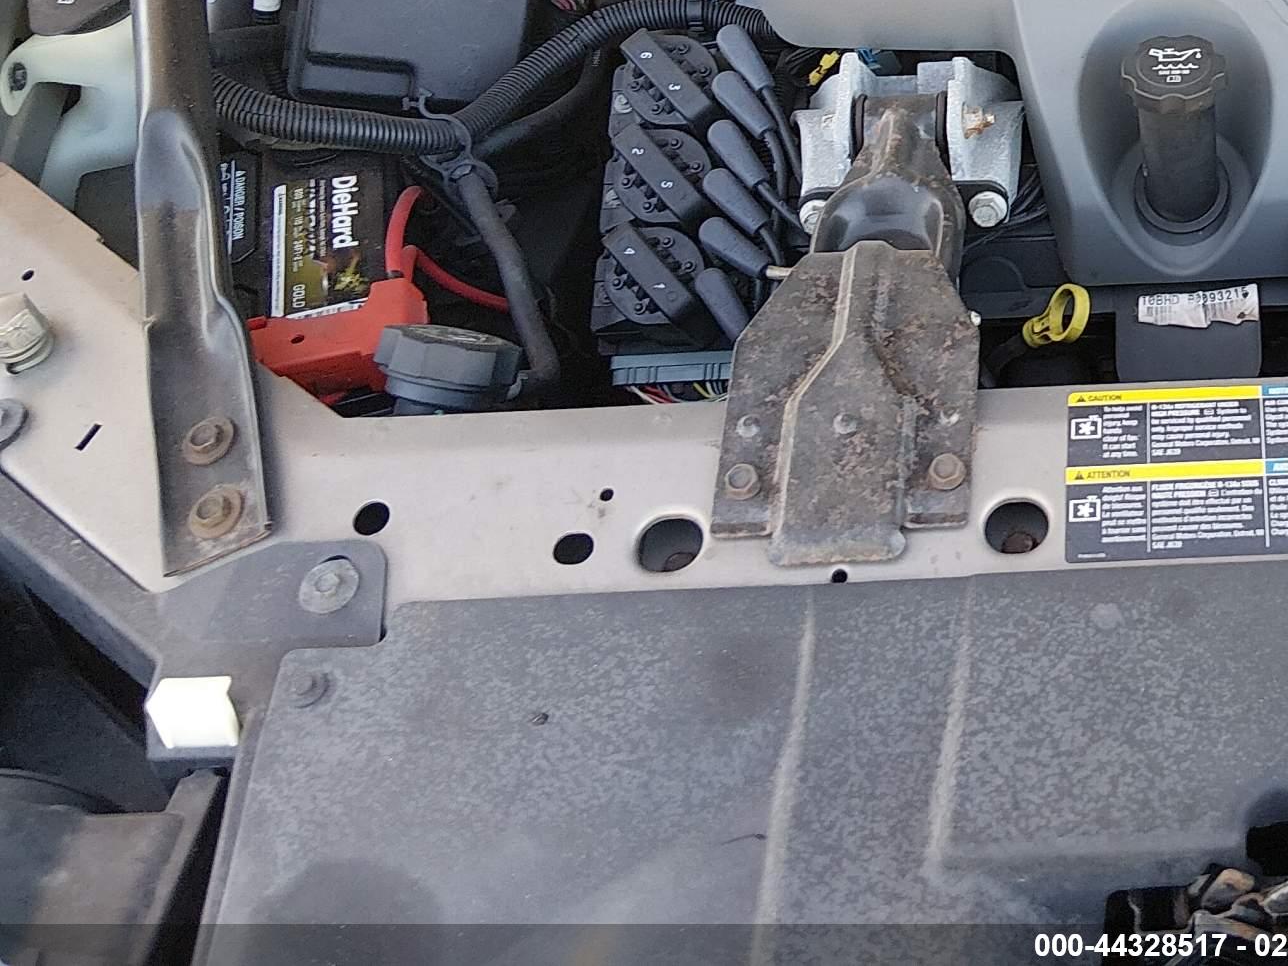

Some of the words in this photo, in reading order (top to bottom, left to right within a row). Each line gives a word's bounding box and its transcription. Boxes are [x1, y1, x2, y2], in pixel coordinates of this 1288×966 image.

[668, 83, 681, 91] 3
[631, 147, 644, 155] 2
[234, 177, 246, 206] DANGER
[332, 174, 360, 250] DieHard
[232, 212, 244, 241] POISON
[623, 247, 636, 255] 4
[292, 284, 306, 308] GOLD
[1088, 394, 1123, 402] CAUTION
[1087, 470, 1131, 479] ATTENTION
